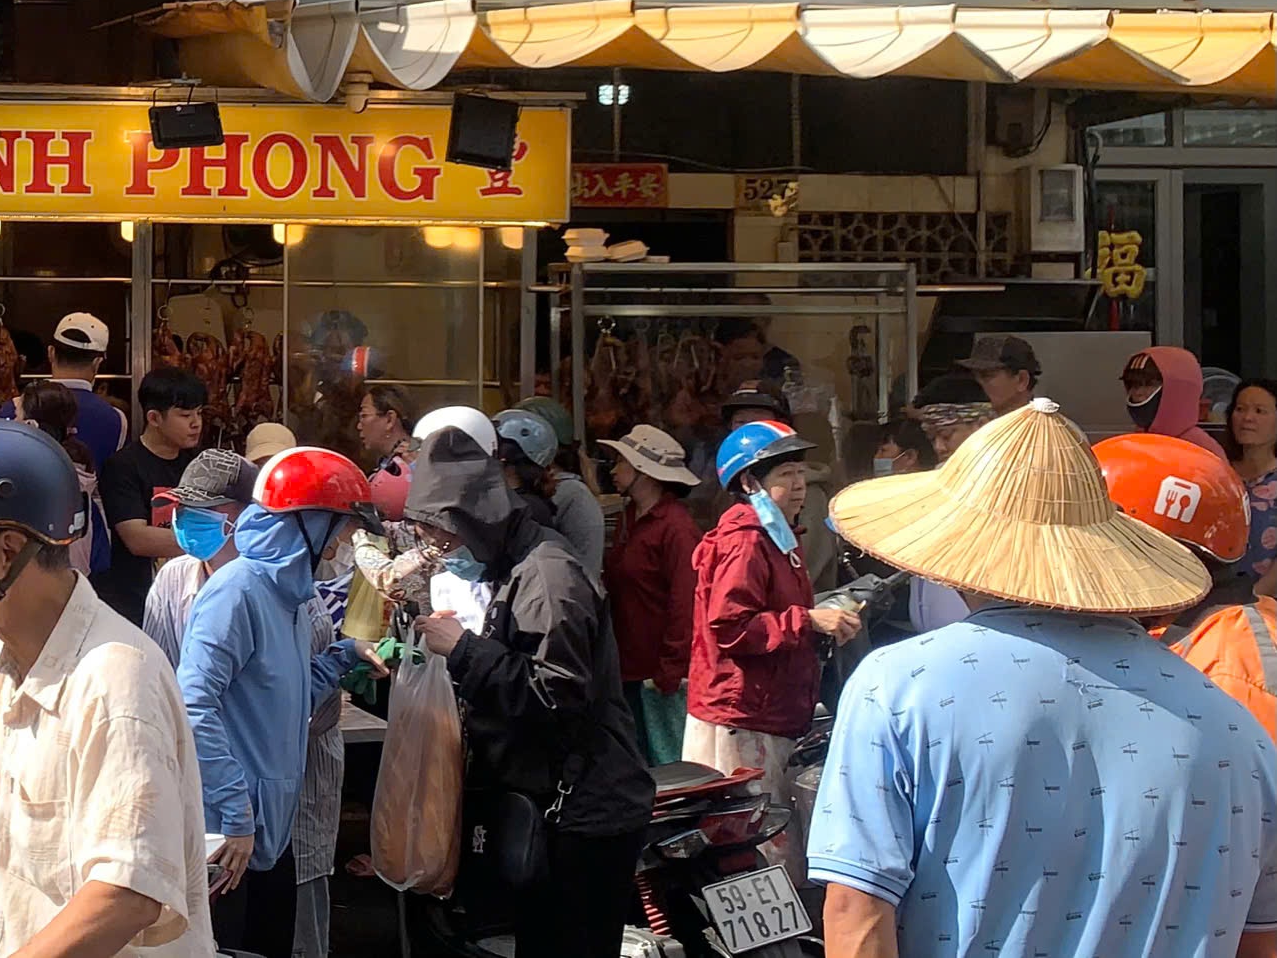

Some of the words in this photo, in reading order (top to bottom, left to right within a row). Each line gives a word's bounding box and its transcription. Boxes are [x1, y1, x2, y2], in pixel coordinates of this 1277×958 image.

[125, 130, 442, 200] PHONG
[716, 875, 780, 914] 59-E1
[722, 901, 798, 948] 718.27
